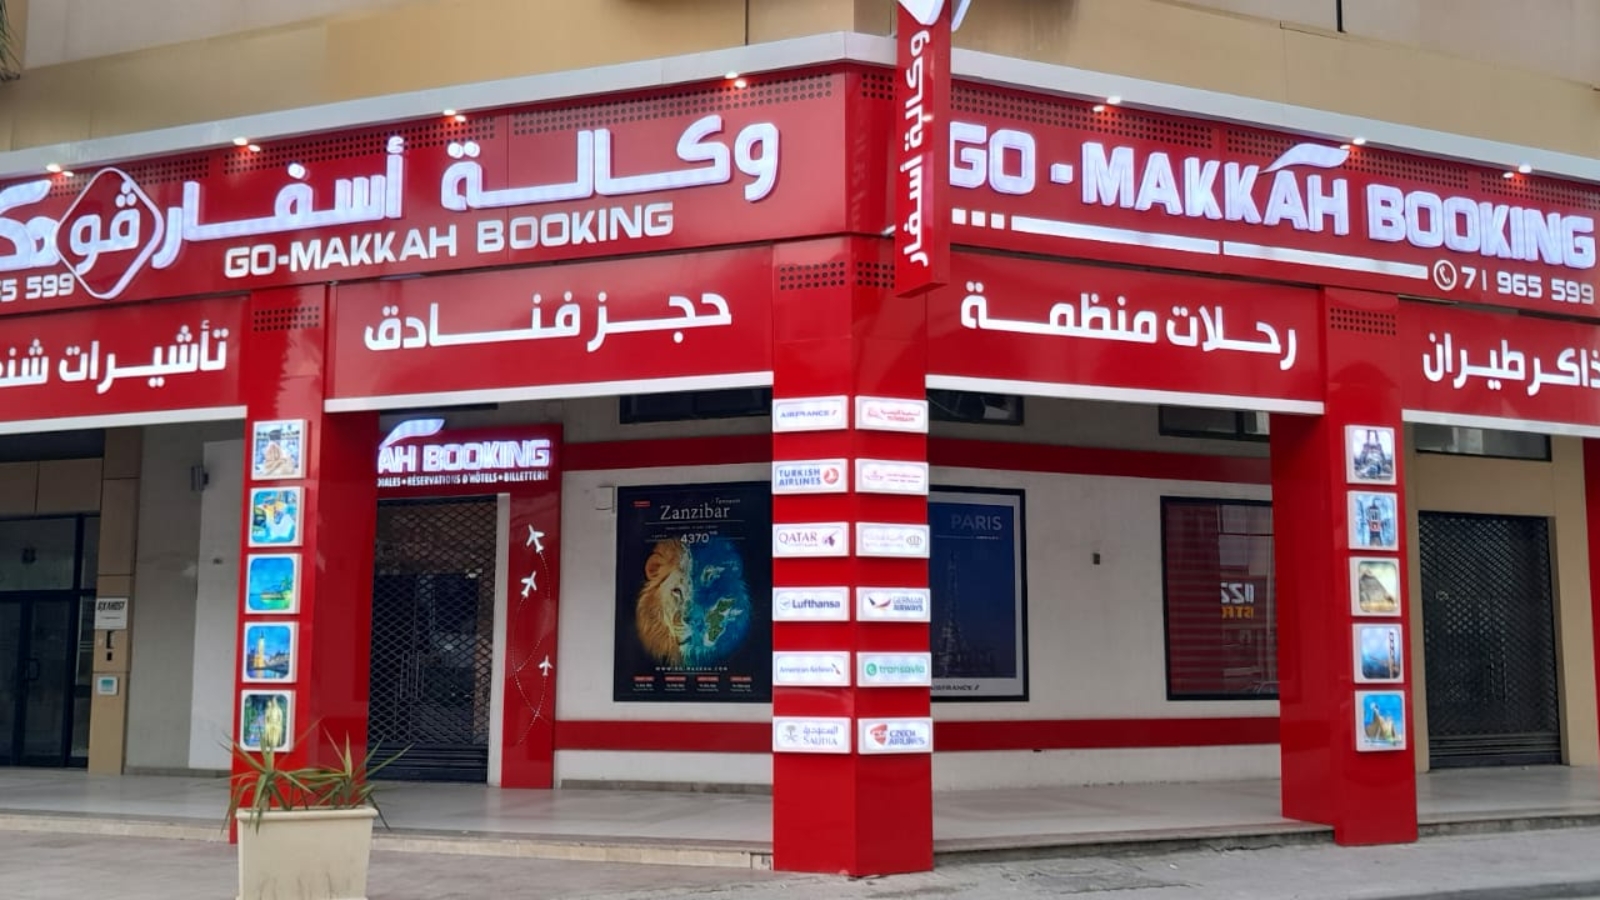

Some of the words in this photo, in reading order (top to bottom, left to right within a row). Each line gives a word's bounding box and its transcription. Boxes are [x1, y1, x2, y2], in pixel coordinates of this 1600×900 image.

[441, 114, 779, 211] وكالة
[151, 136, 404, 269] أسفار
[900, 155, 929, 266] أسفار
[950, 121, 1036, 195] GO
[1082, 141, 1350, 236] MAKKAH
[1366, 183, 1596, 270] BOOKING
[224, 225, 457, 279] GO-MAKKAH
[477, 201, 674, 254] BOOKING
[25, 273, 76, 300] 599
[1496, 272, 1542, 299] 965
[1551, 277, 1595, 305] 599
[364, 291, 581, 351] فنادق
[587, 290, 732, 353] حجز
[961, 281, 1157, 344] منظمة
[1166, 306, 1296, 371] رحلات
[58, 319, 230, 394] تأشيرات
[1423, 332, 1526, 391] طيران
[1527, 347, 1600, 396] ذاكر
[422, 439, 550, 473] BOOKING
[779, 468, 821, 477] TURKISH
[779, 476, 821, 487] AIRLINES
[660, 502, 731, 520] Zanzibar
[951, 514, 1002, 530] PARIS
[681, 533, 709, 544] 4370
[779, 531, 817, 544] QATAR
[792, 599, 841, 610] Lufthansa
[893, 604, 924, 612] AIRWAYS
[879, 665, 925, 675] transavia
[803, 737, 838, 746] SAUDIA
[888, 736, 925, 746] AIRLINES
[889, 729, 916, 737] CZECH
